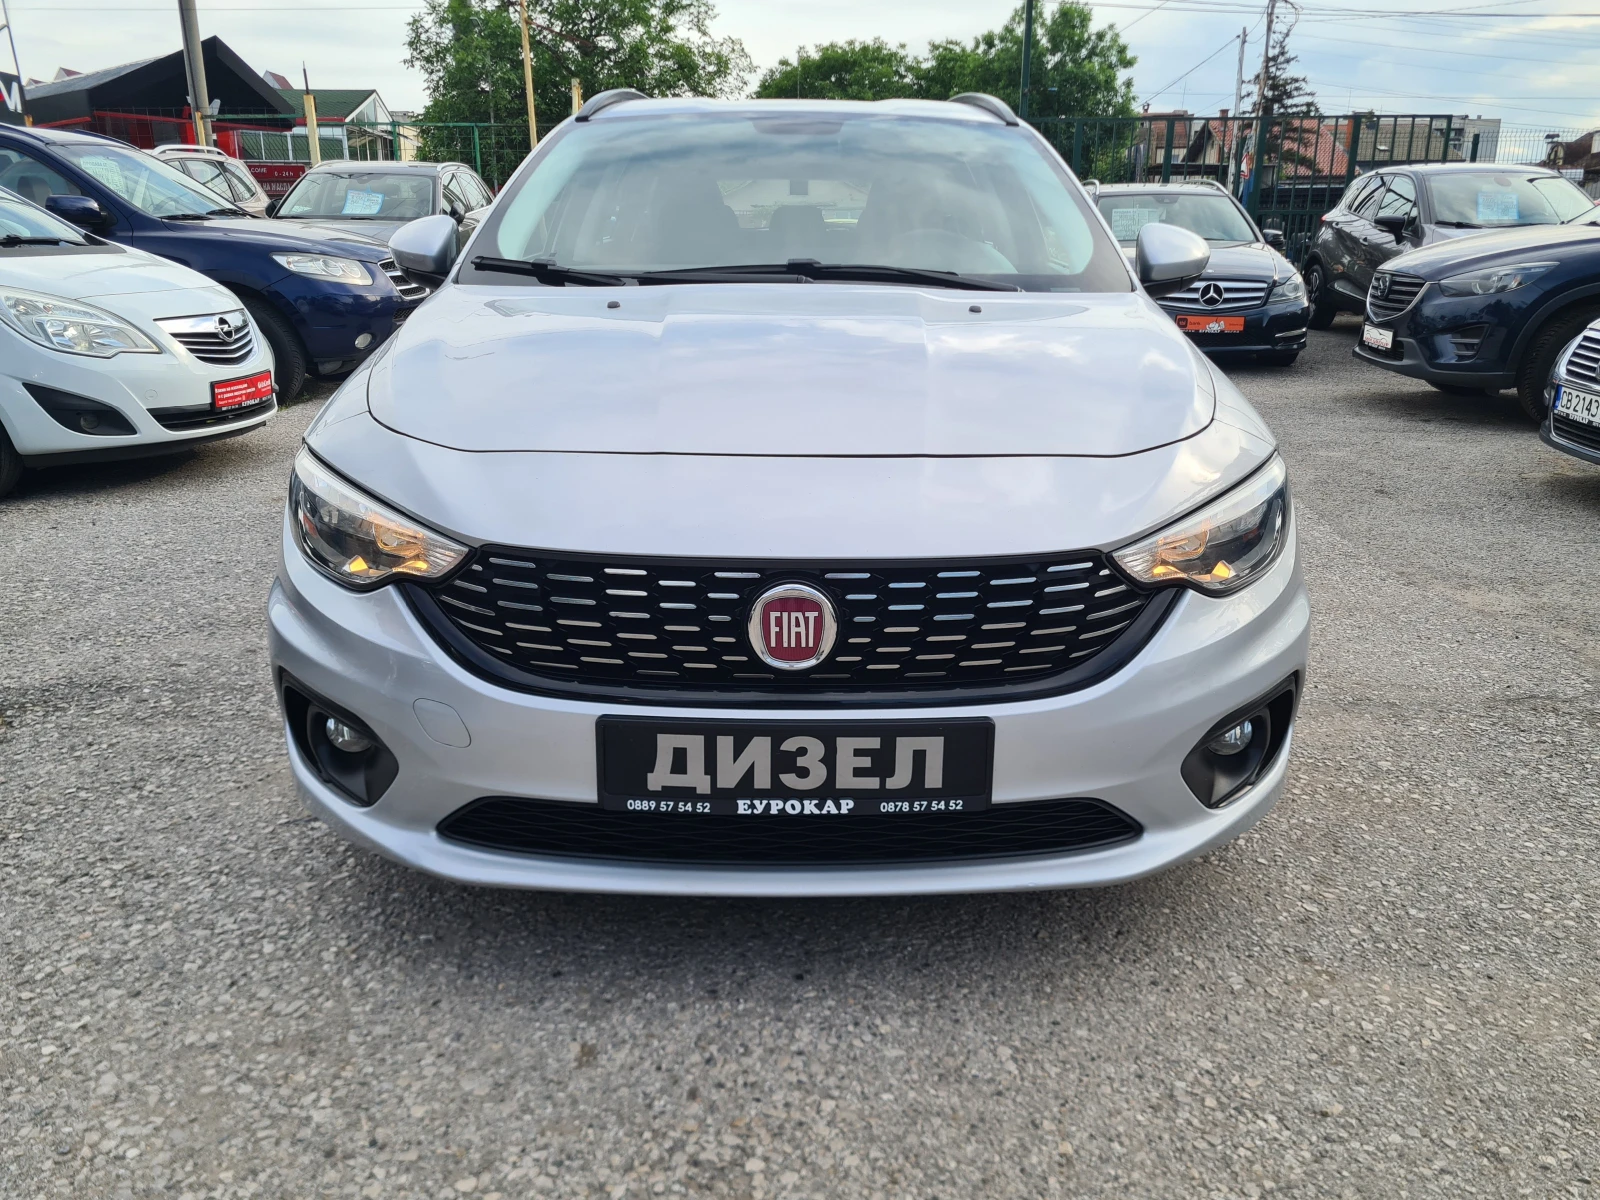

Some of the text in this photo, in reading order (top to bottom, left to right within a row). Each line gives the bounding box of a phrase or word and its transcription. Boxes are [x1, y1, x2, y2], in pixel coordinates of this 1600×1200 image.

[769, 611, 819, 648] FIAT
[647, 733, 945, 795] ДИЗЕЛ
[626, 799, 711, 813] 0889 57 54 52
[736, 799, 855, 815] ЕУРОКАР
[880, 799, 964, 813] 0878 57 54 52
